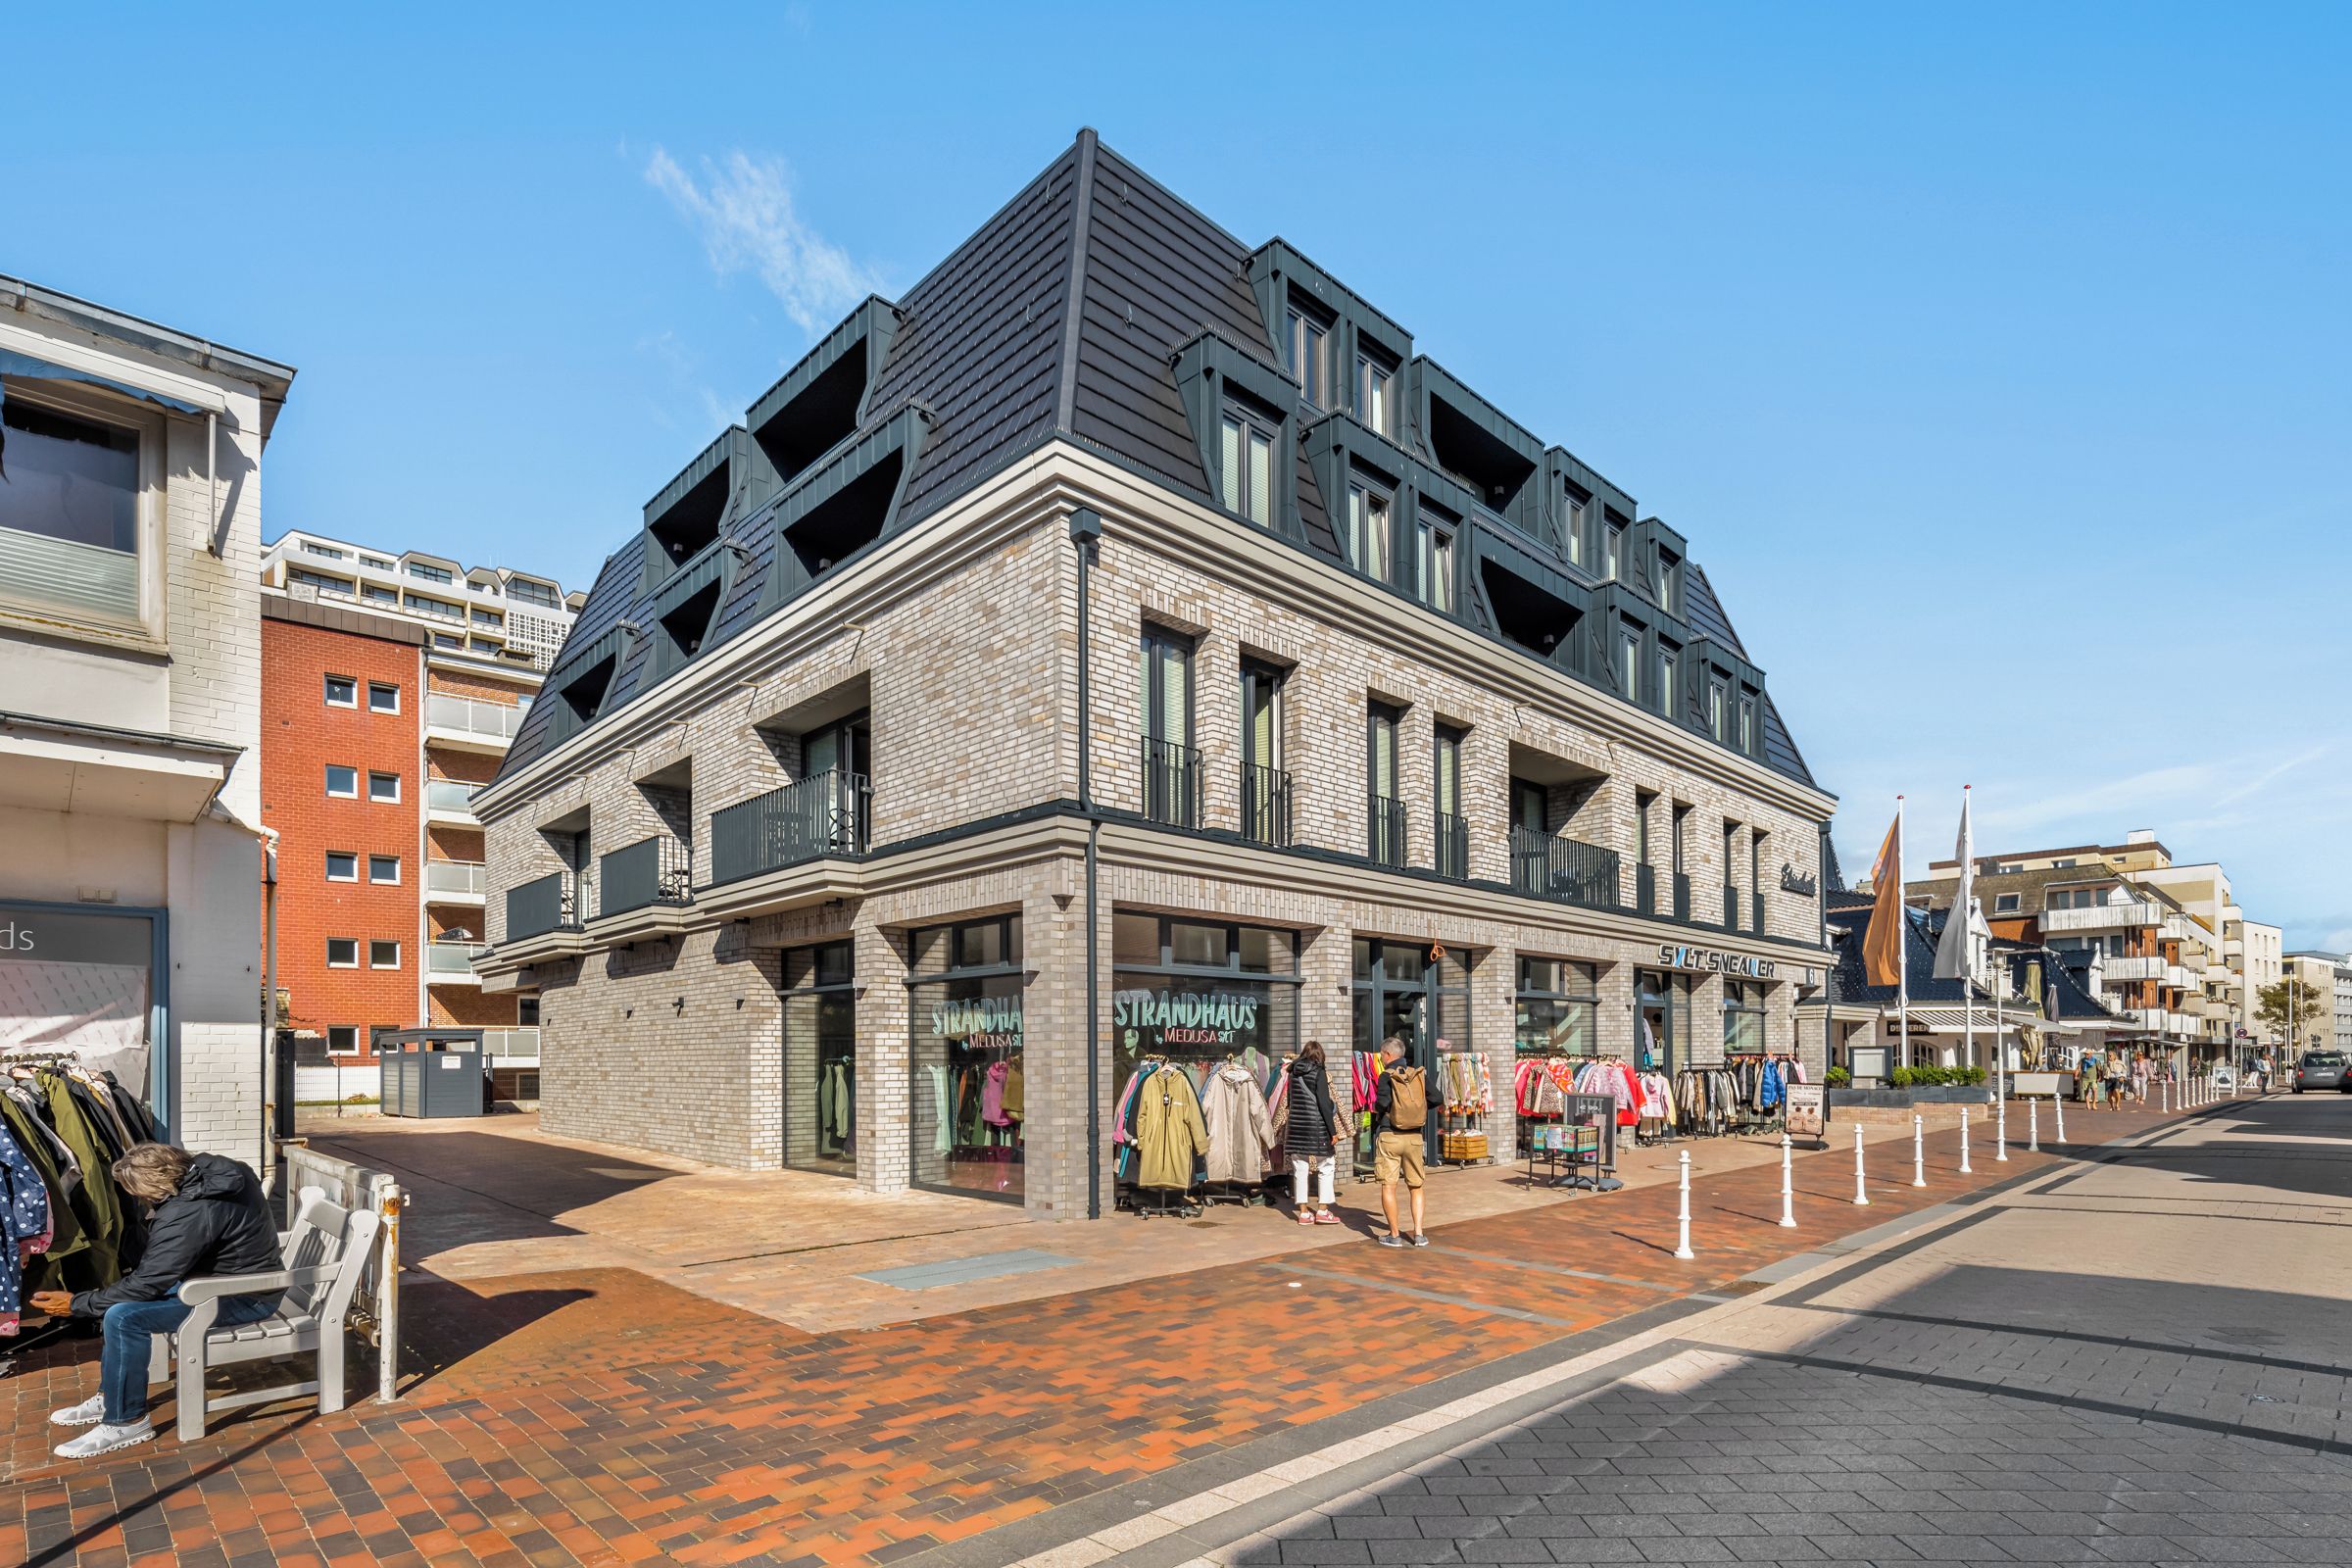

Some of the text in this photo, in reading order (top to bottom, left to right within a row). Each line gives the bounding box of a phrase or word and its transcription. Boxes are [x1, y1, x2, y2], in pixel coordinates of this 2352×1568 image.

[1658, 944, 1775, 978] SYLT SNEAKER
[1809, 968, 1814, 984] 6
[1113, 989, 1257, 1030] STRANDHAUS
[969, 1033, 1012, 1049] MEDUSA
[1164, 1028, 1217, 1043] MEDUSA
